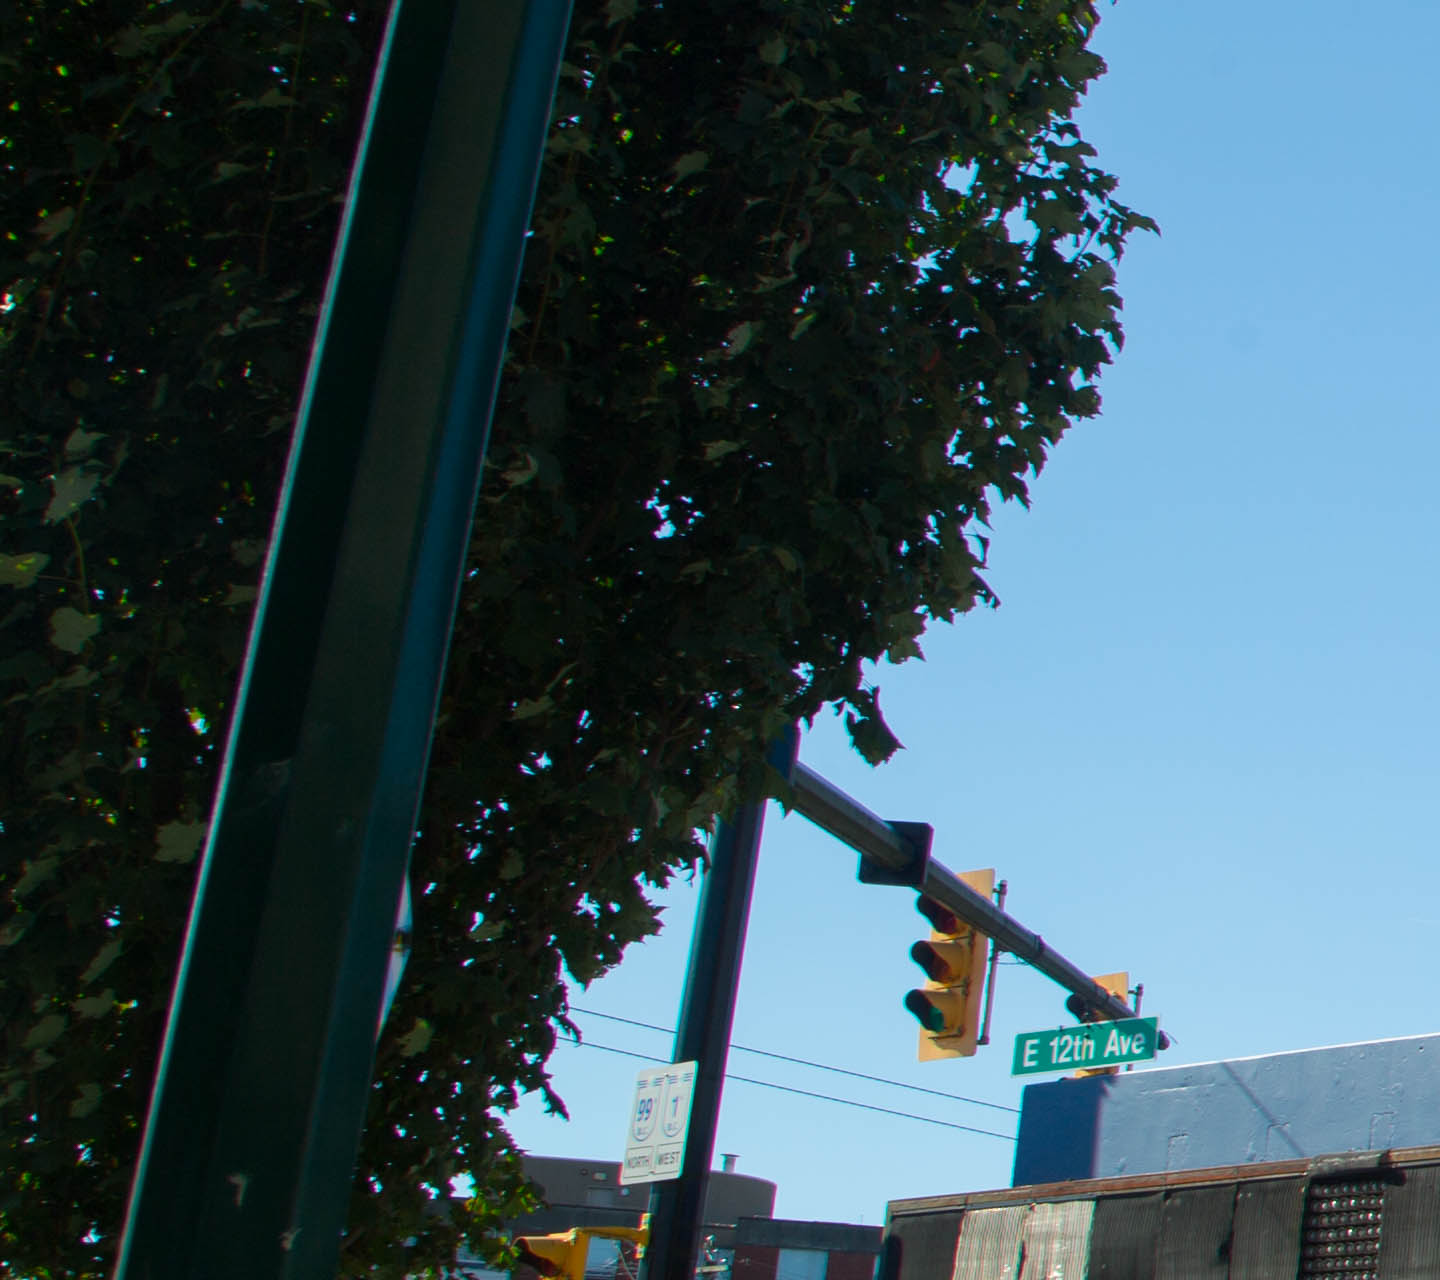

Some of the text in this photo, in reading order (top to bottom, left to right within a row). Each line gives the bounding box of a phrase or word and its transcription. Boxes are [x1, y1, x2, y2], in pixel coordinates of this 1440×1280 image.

[1023, 1029, 1145, 1067] E 12th Ave
[637, 1096, 679, 1122] 99 1
[627, 1151, 681, 1168] NORTH WEST
